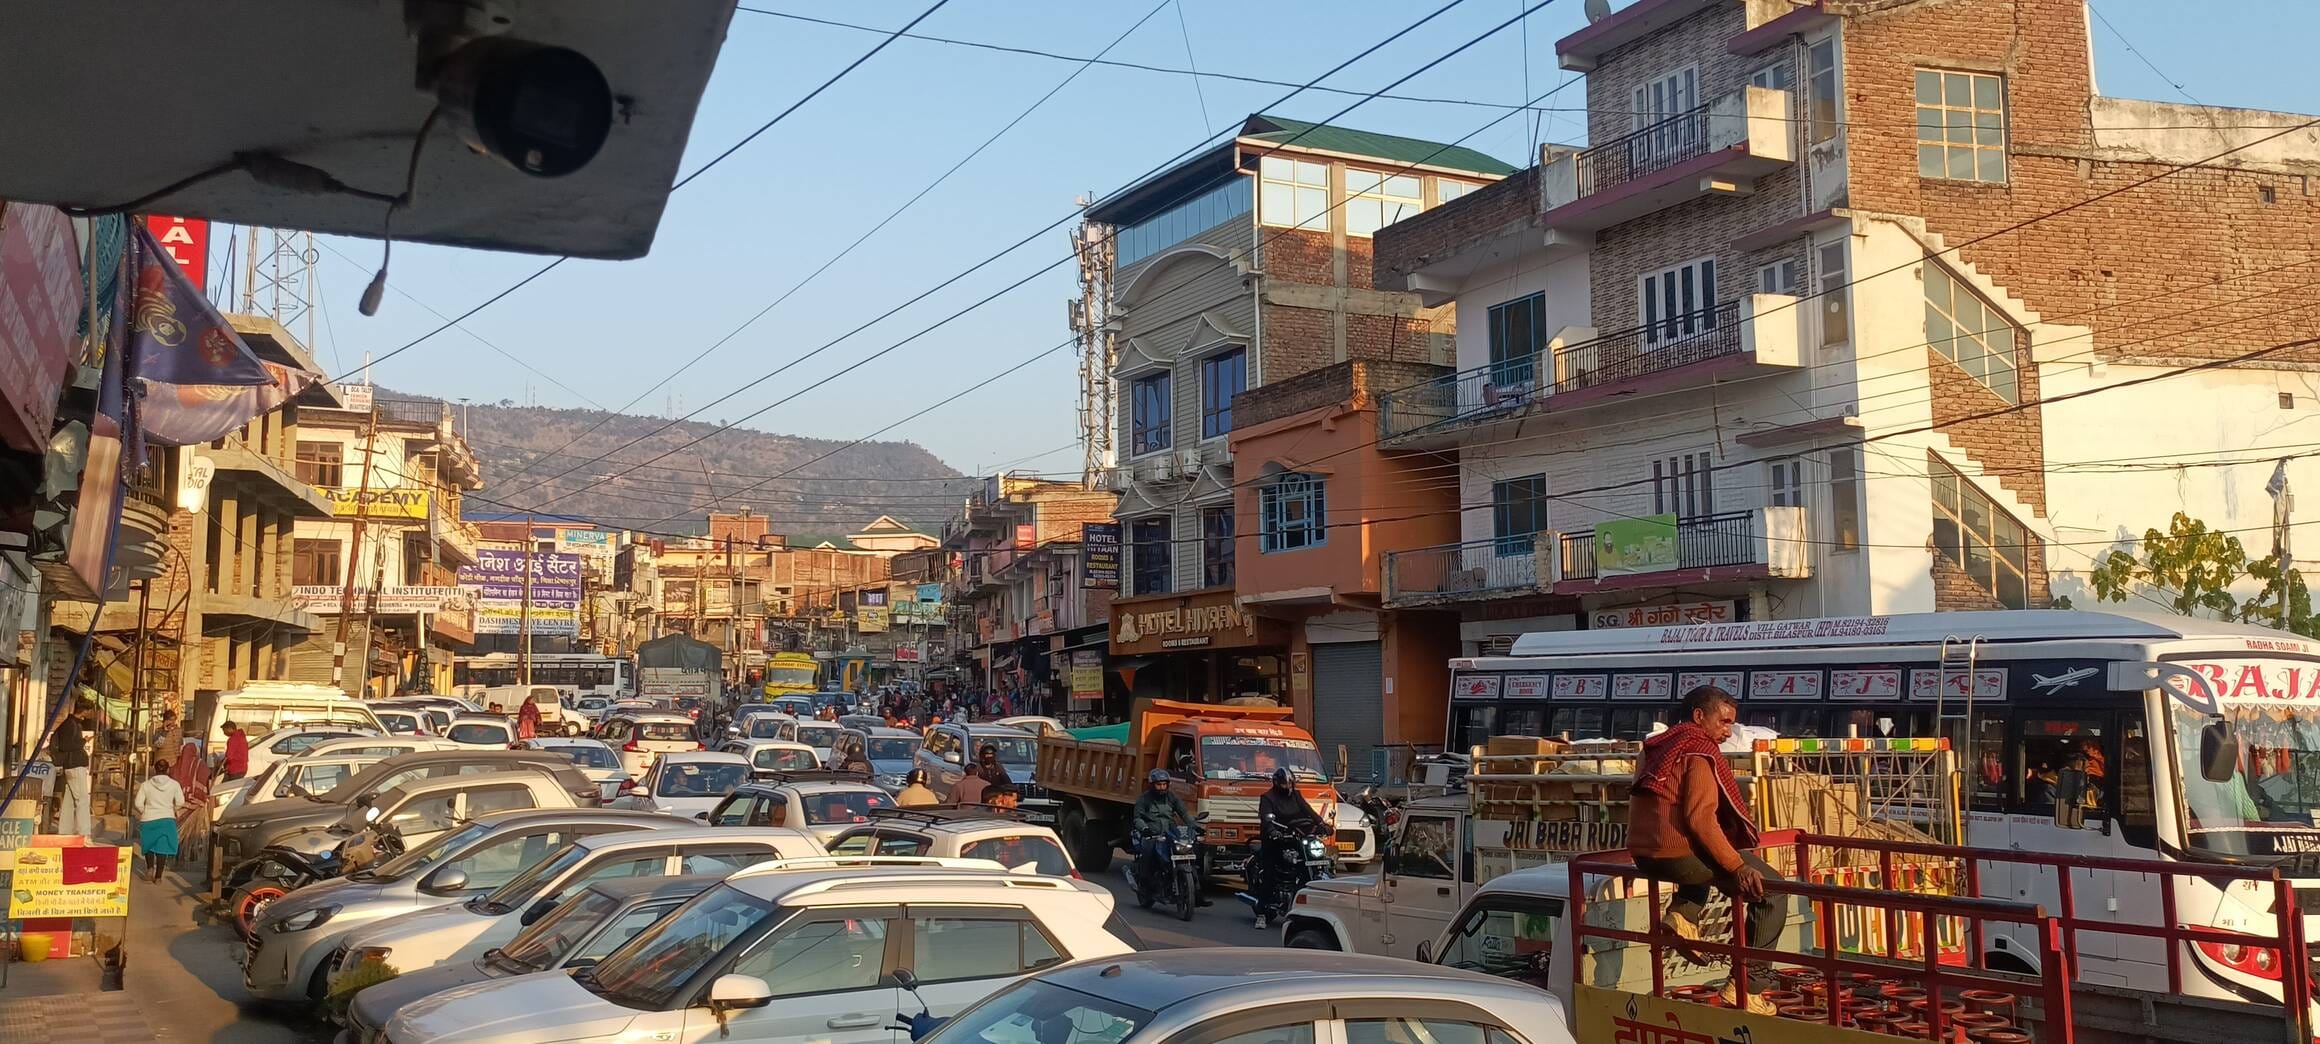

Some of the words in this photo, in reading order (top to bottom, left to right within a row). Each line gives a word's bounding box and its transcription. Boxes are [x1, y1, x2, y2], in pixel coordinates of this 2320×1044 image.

[567, 531, 606, 541] MINERVA
[1089, 534, 1117, 543] HOTEL
[300, 586, 327, 598] INDO
[544, 618, 575, 627] CENTRE
[1713, 627, 1751, 642] TRAVELS
[2246, 640, 2274, 650] RADHA
[2275, 641, 2300, 652] SOAMI
[1503, 821, 1531, 849] JAI
[1536, 821, 1582, 851] BABA
[66, 888, 106, 896] TRANSFER
